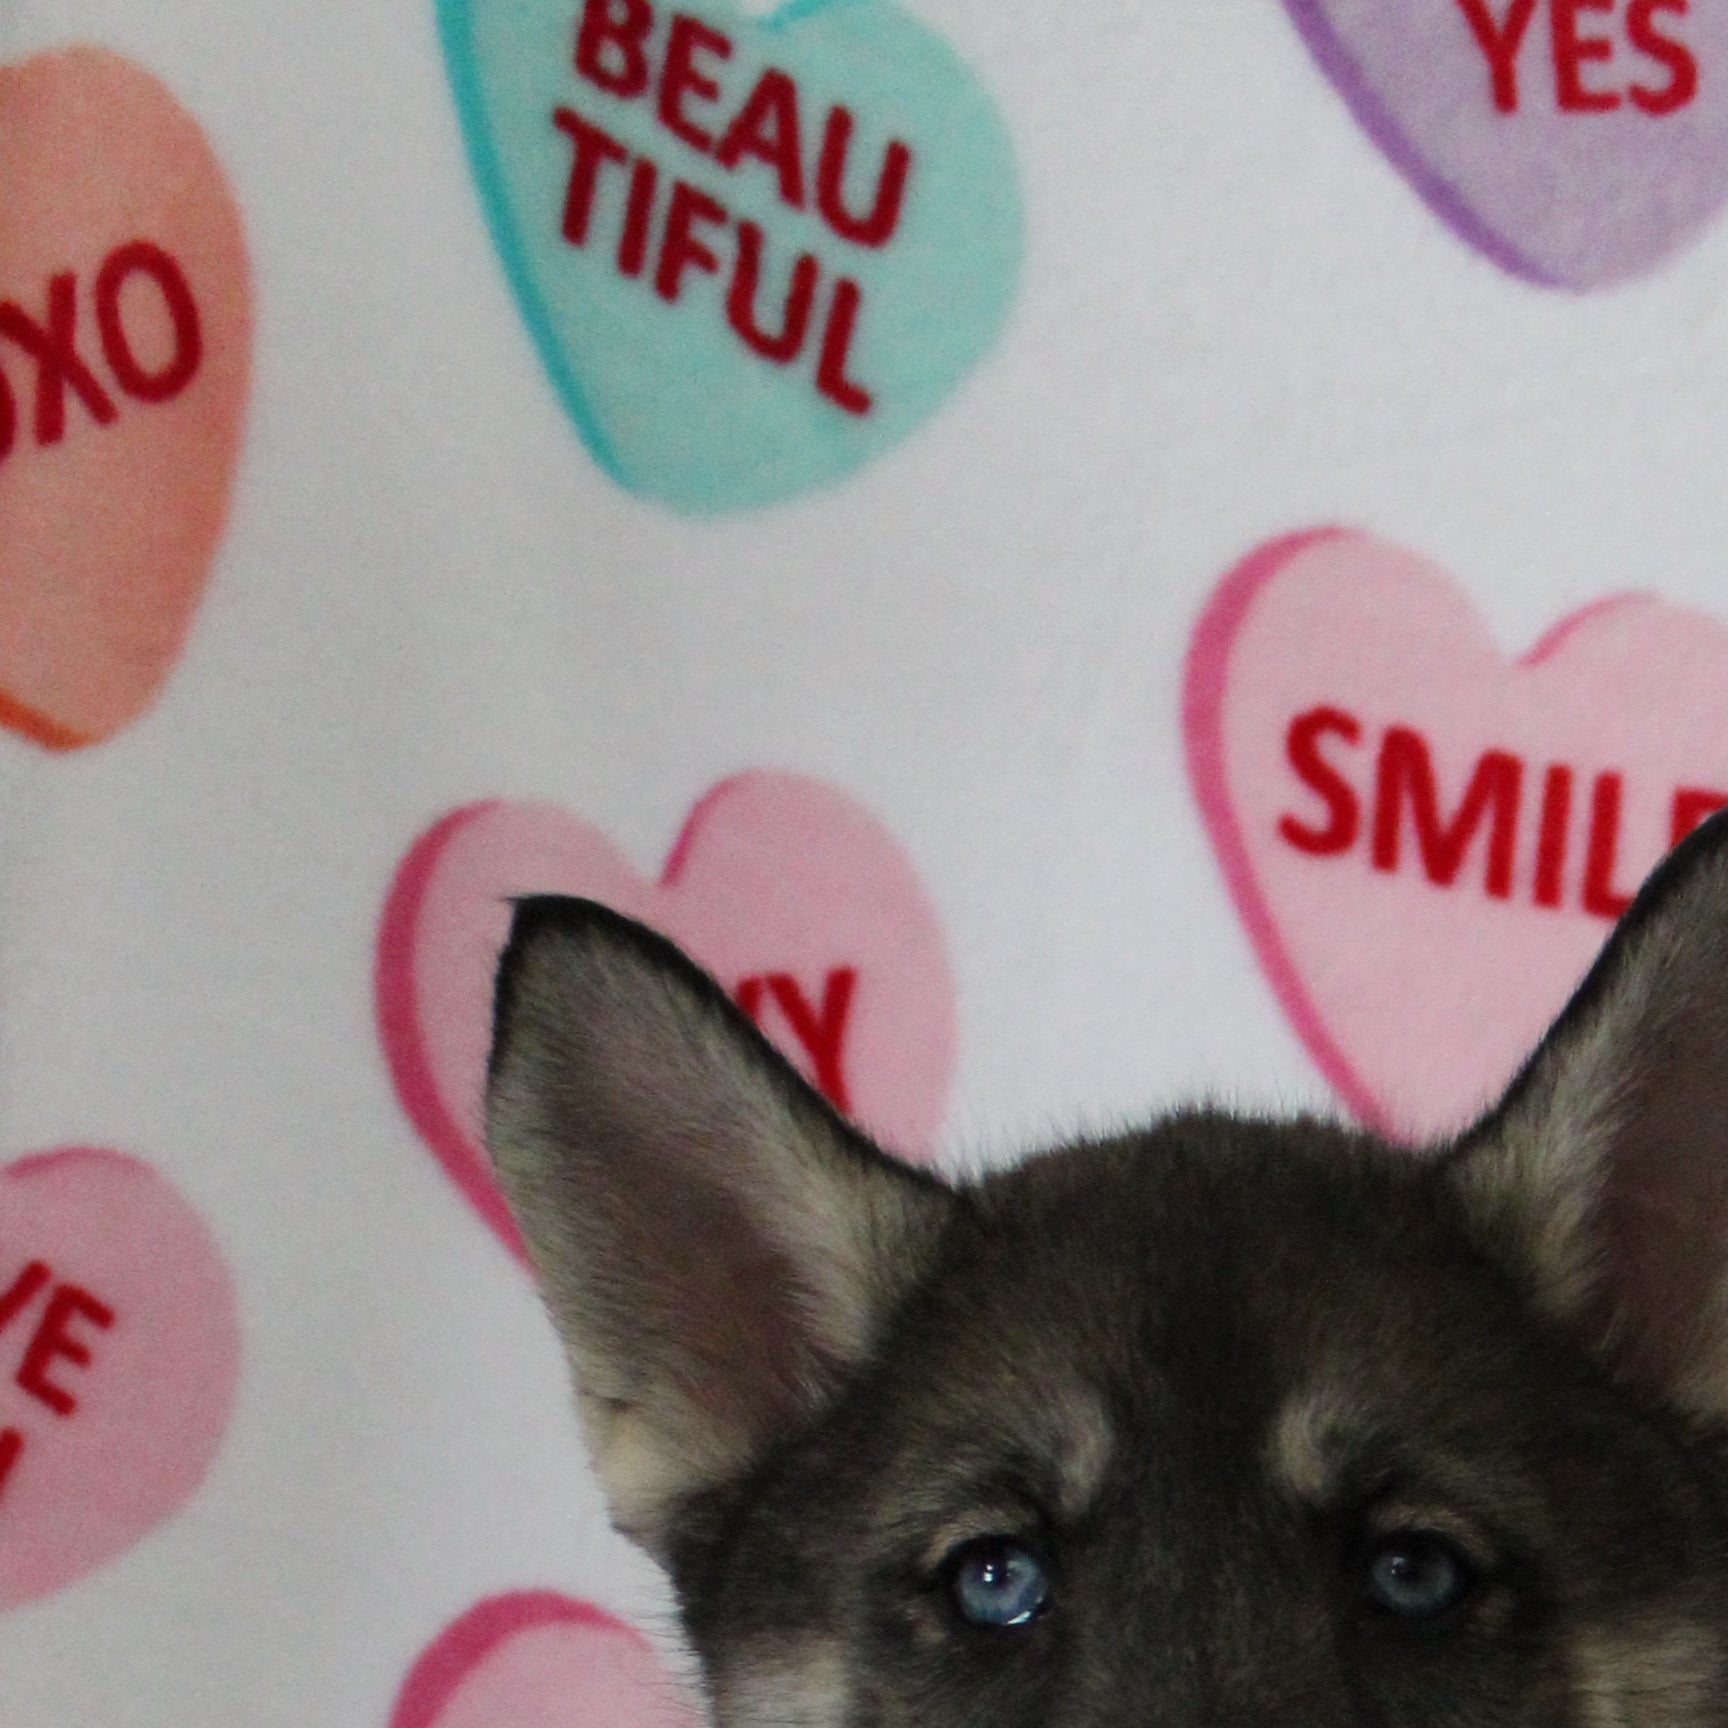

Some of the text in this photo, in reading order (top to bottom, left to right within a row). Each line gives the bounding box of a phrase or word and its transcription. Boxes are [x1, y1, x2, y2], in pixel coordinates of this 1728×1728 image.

[574, 0, 912, 249] BEAU
[1457, 0, 1698, 117] YES
[0, 240, 202, 462] XO
[552, 105, 873, 417] TIFUL
